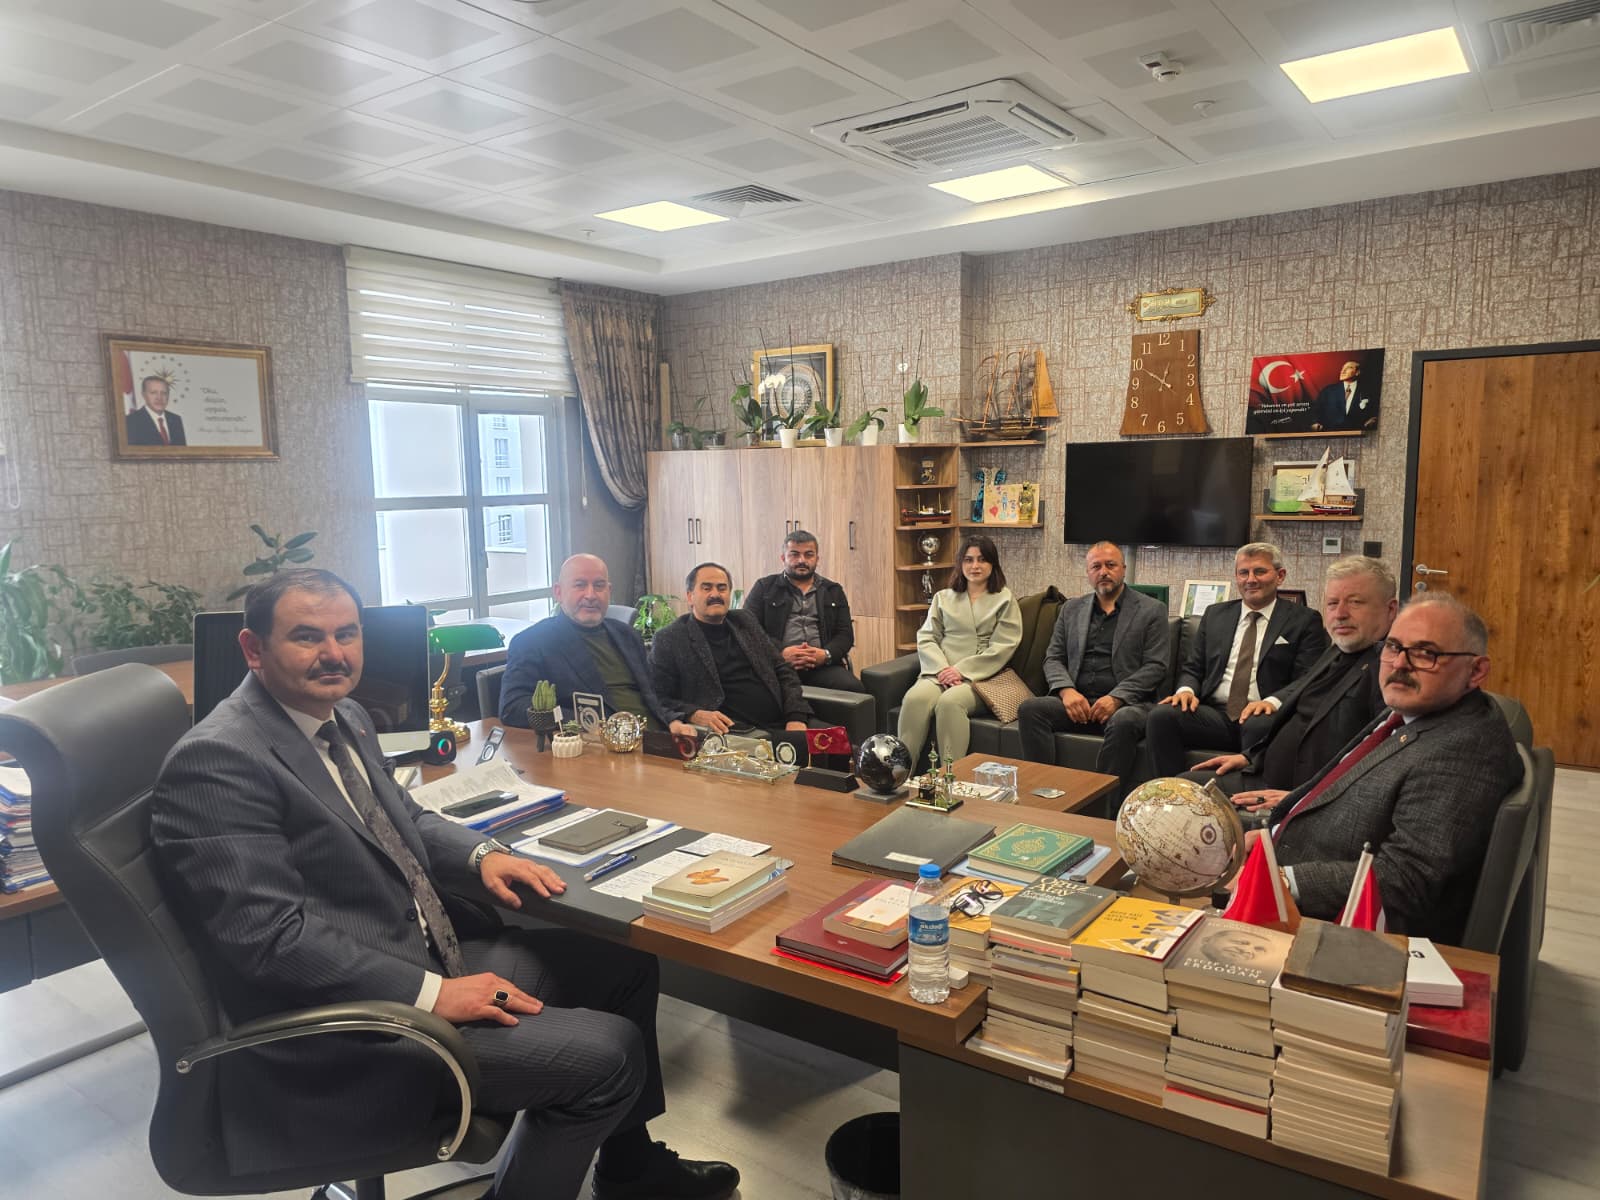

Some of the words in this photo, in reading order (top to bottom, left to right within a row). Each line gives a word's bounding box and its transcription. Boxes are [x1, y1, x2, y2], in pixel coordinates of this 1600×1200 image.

[1158, 332, 1171, 346] 12
[1179, 338, 1185, 352] 1
[1142, 342, 1152, 355] 11
[1132, 358, 1143, 371] 10
[1187, 353, 1195, 368] 2
[1131, 377, 1140, 391] 9
[1186, 373, 1195, 387] 3
[1130, 396, 1139, 409] 8
[1185, 392, 1195, 406] 4
[1140, 413, 1148, 427] 7
[1176, 412, 1184, 425] 5
[1157, 420, 1166, 433] 6
